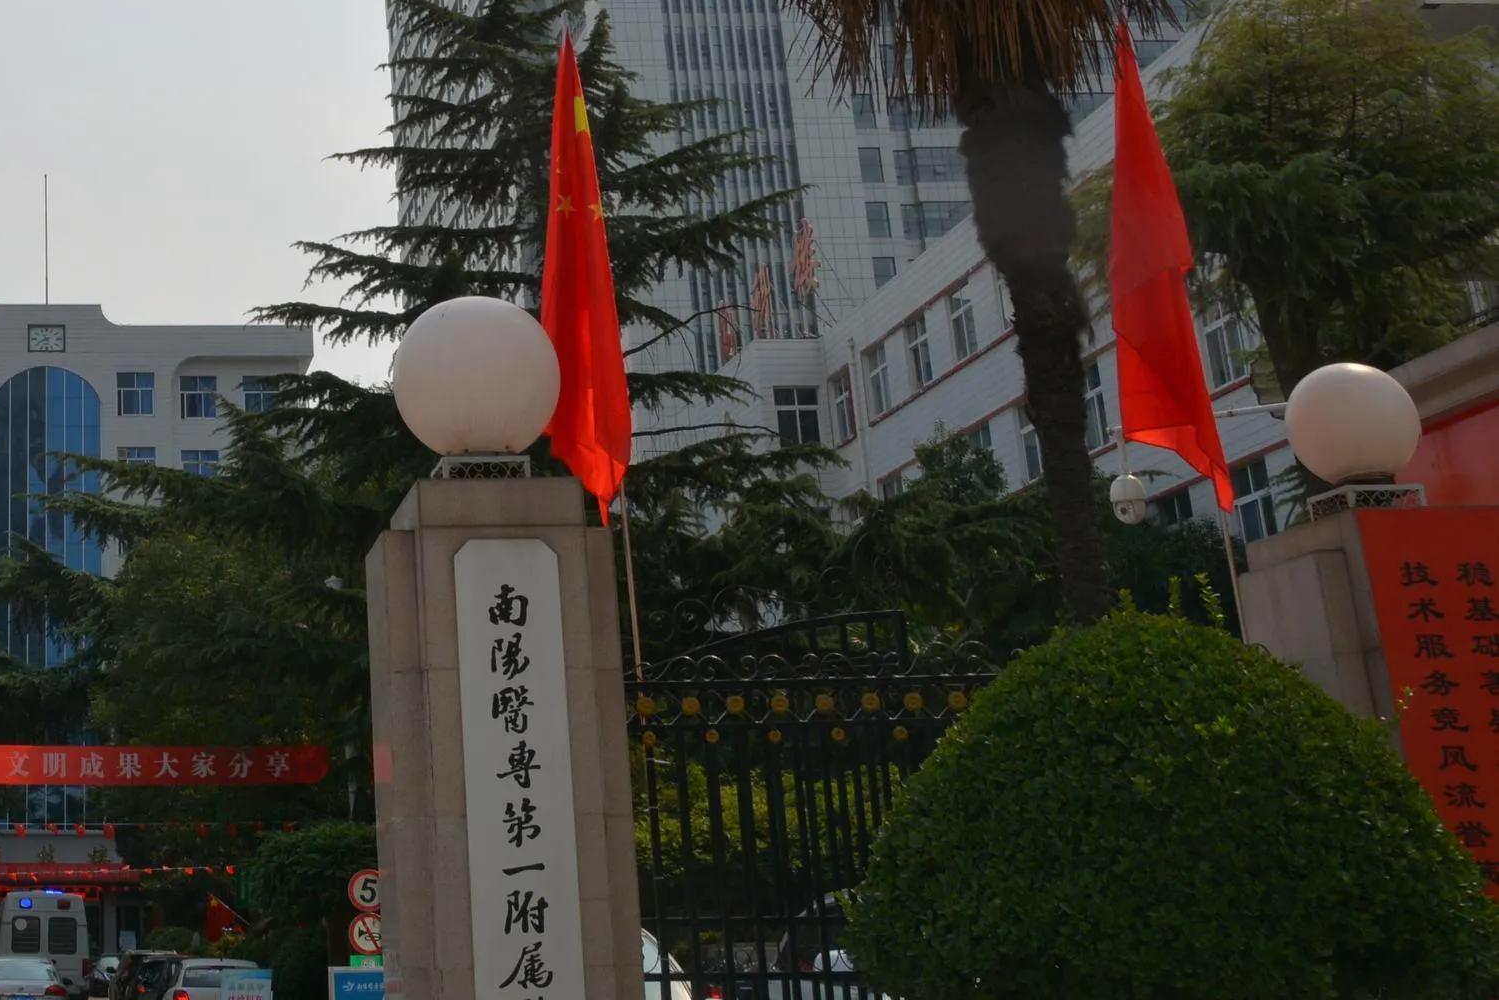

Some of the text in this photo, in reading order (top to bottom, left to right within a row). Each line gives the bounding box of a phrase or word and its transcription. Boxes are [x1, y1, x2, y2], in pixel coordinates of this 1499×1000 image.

[6, 751, 291, 778] 文明成果大家分享
[489, 584, 554, 1000] 南陽醫專第一附属
[360, 878, 378, 903] 5
